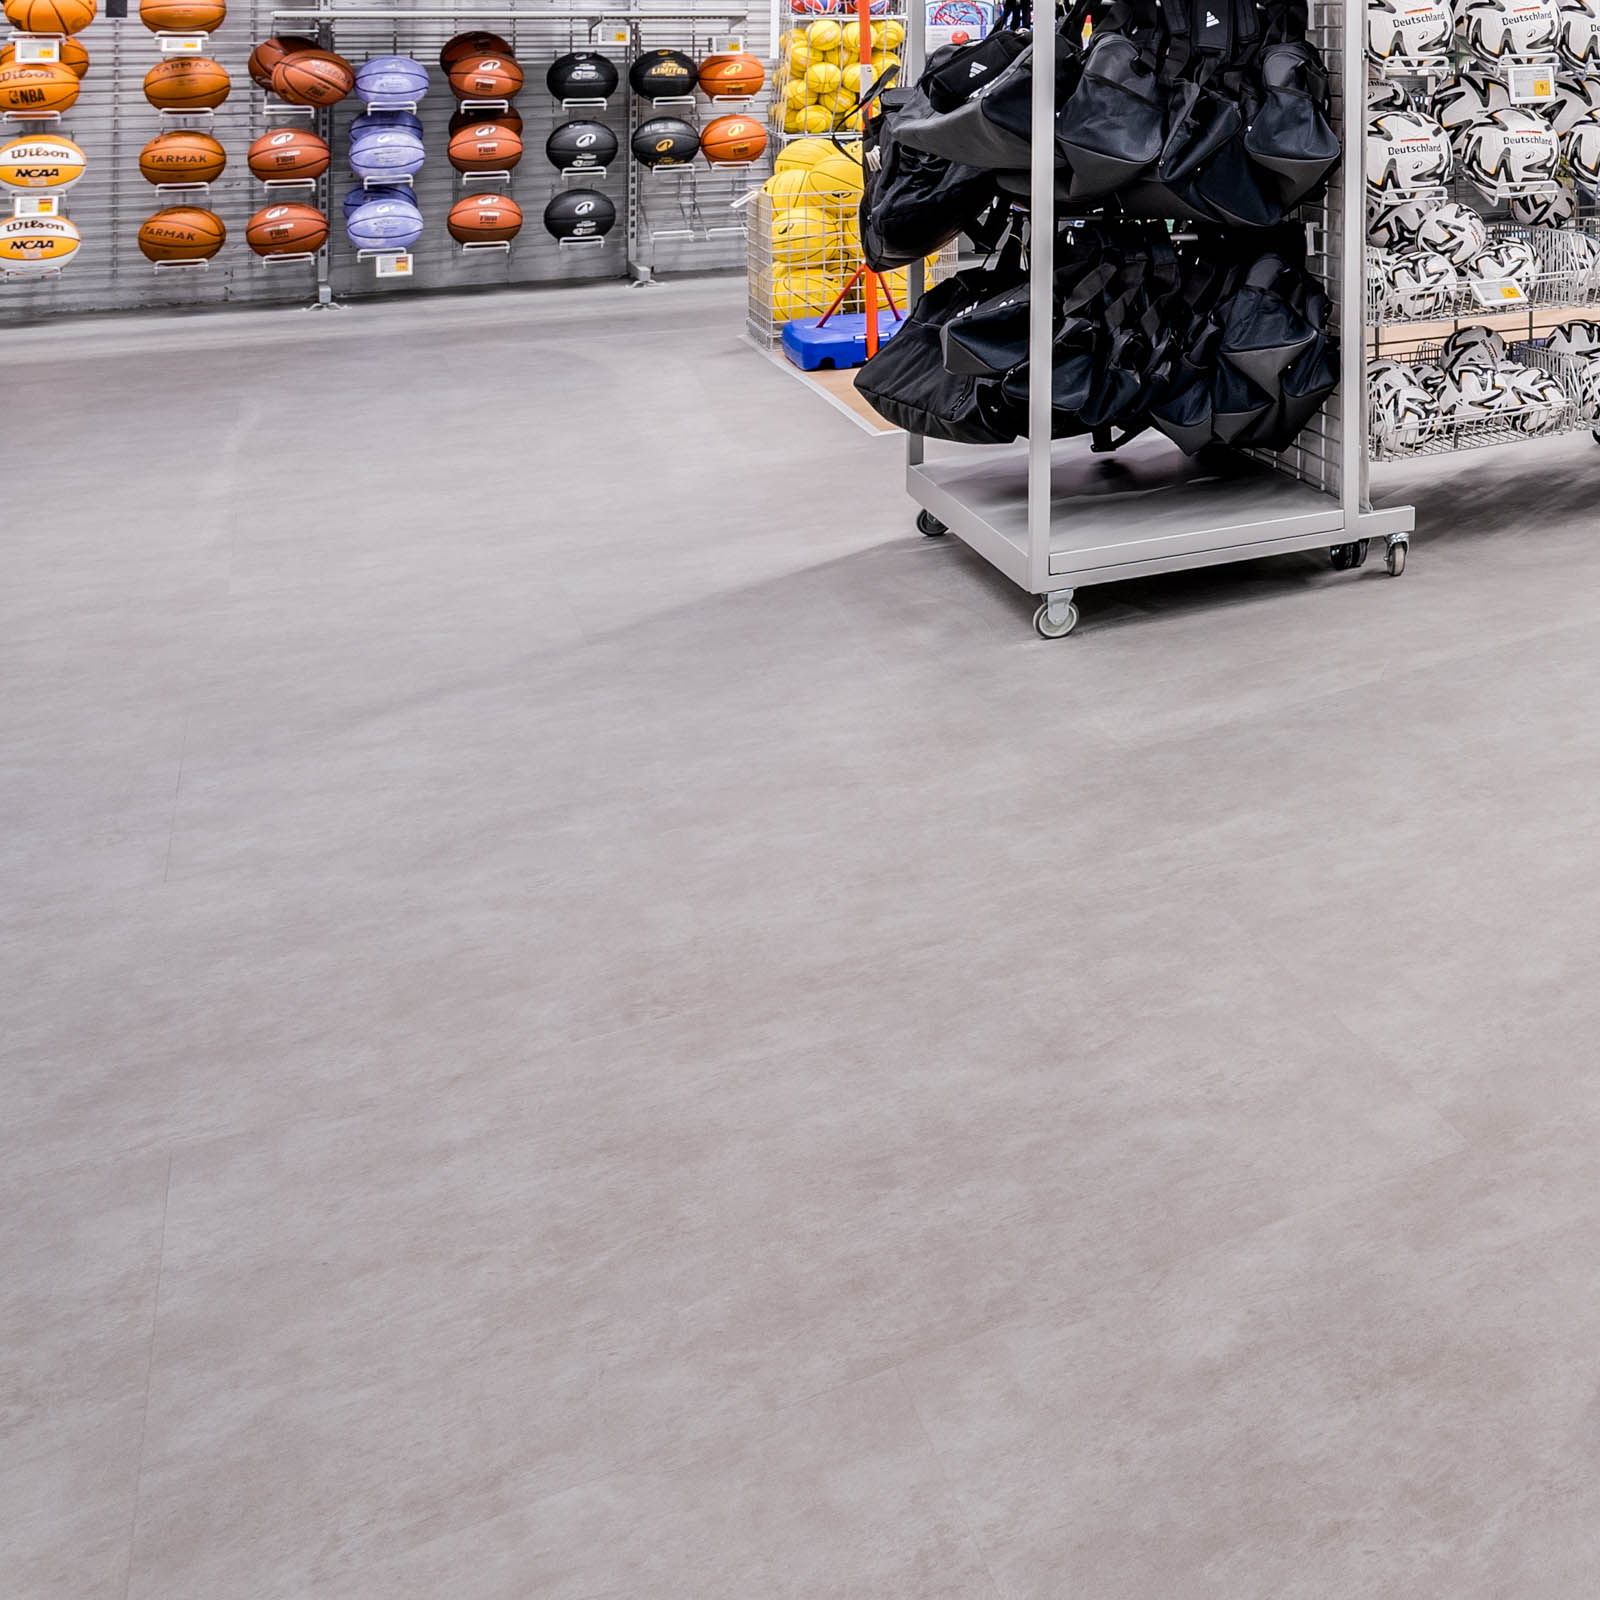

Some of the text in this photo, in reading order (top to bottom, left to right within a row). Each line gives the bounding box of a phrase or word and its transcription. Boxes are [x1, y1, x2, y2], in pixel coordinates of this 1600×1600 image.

[1392, 12, 1445, 28] Deutschland
[1501, 11, 1552, 27] Deutschland
[19, 88, 46, 103] NBA
[1503, 136, 1552, 146] Deutschland
[10, 148, 70, 160] Wilson
[1388, 144, 1441, 156] Deutschland
[151, 154, 207, 164] TARMAK
[15, 168, 60, 178] NCAA
[6, 219, 65, 232] Wilson
[144, 227, 196, 241] TARMAK
[10, 240, 54, 250] NCAA
